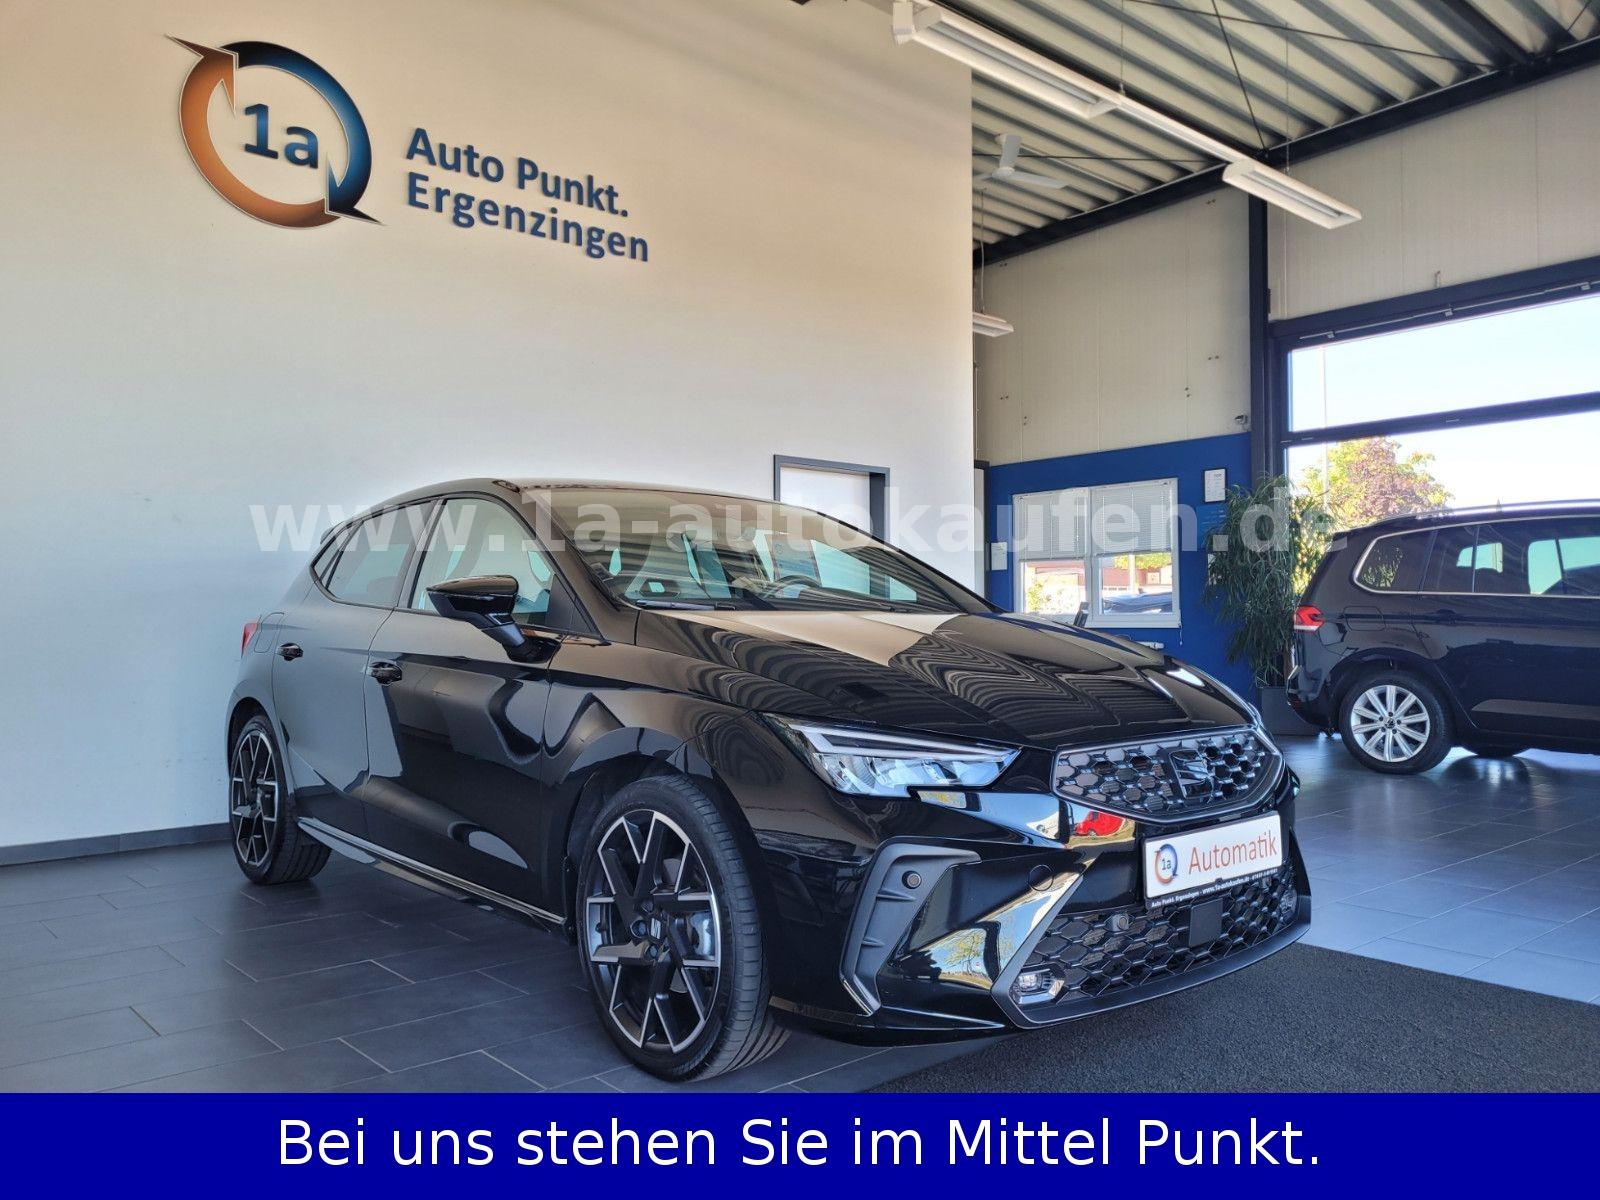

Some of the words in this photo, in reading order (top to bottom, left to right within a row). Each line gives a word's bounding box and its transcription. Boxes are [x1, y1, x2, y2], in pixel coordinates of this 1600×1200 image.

[243, 103, 319, 169] 1a
[406, 127, 505, 183] Auto
[517, 156, 629, 218] Punkt.
[407, 171, 649, 262] Ergenzingen
[1161, 857, 1172, 871] 1a
[1188, 830, 1278, 875] Automatik
